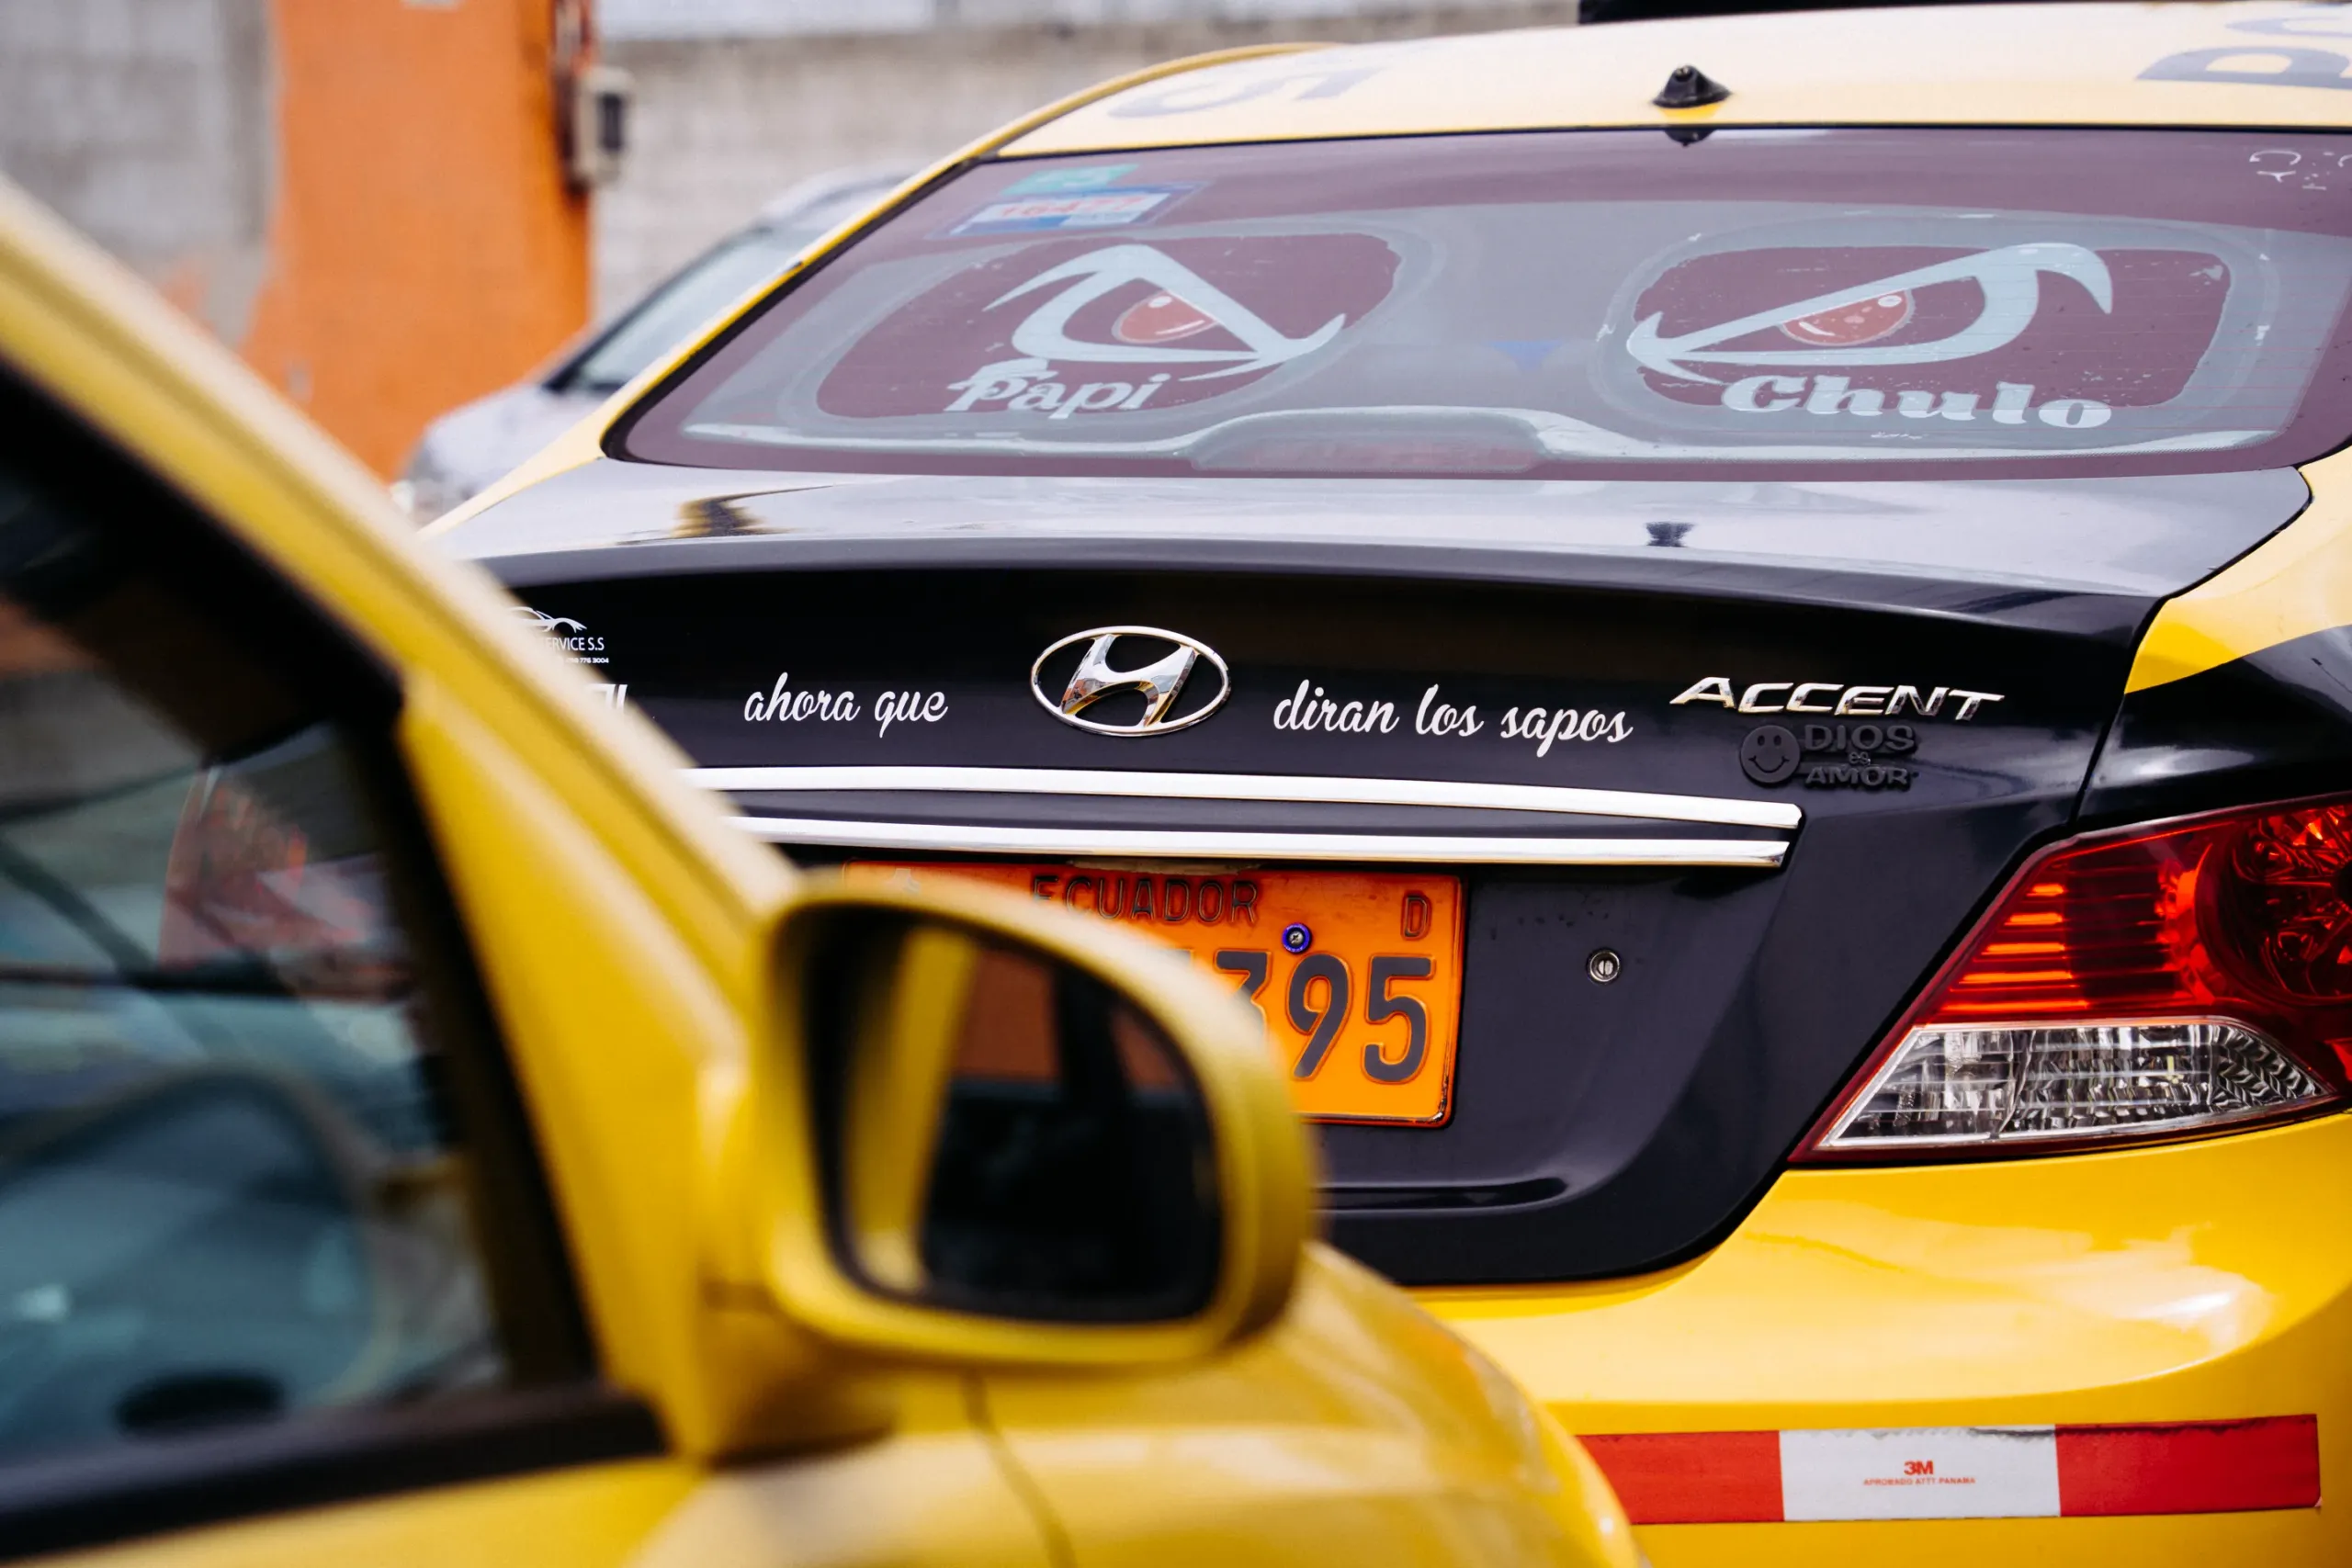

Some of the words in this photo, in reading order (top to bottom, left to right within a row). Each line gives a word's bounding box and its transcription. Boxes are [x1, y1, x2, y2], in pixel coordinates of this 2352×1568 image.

[943, 356, 1171, 421] Papi
[1721, 375, 2112, 428] Chulo
[547, 637, 585, 650] ERVICE
[743, 671, 861, 722] ahora
[874, 691, 948, 739] que
[1273, 679, 1400, 734] diran
[1415, 683, 1485, 737] los
[1499, 705, 1634, 758] sapos
[1669, 676, 2005, 722] ACCENT
[1804, 724, 1917, 751] DIOS
[1804, 765, 1910, 787] AMOR
[1903, 1460, 1934, 1475] 3M
